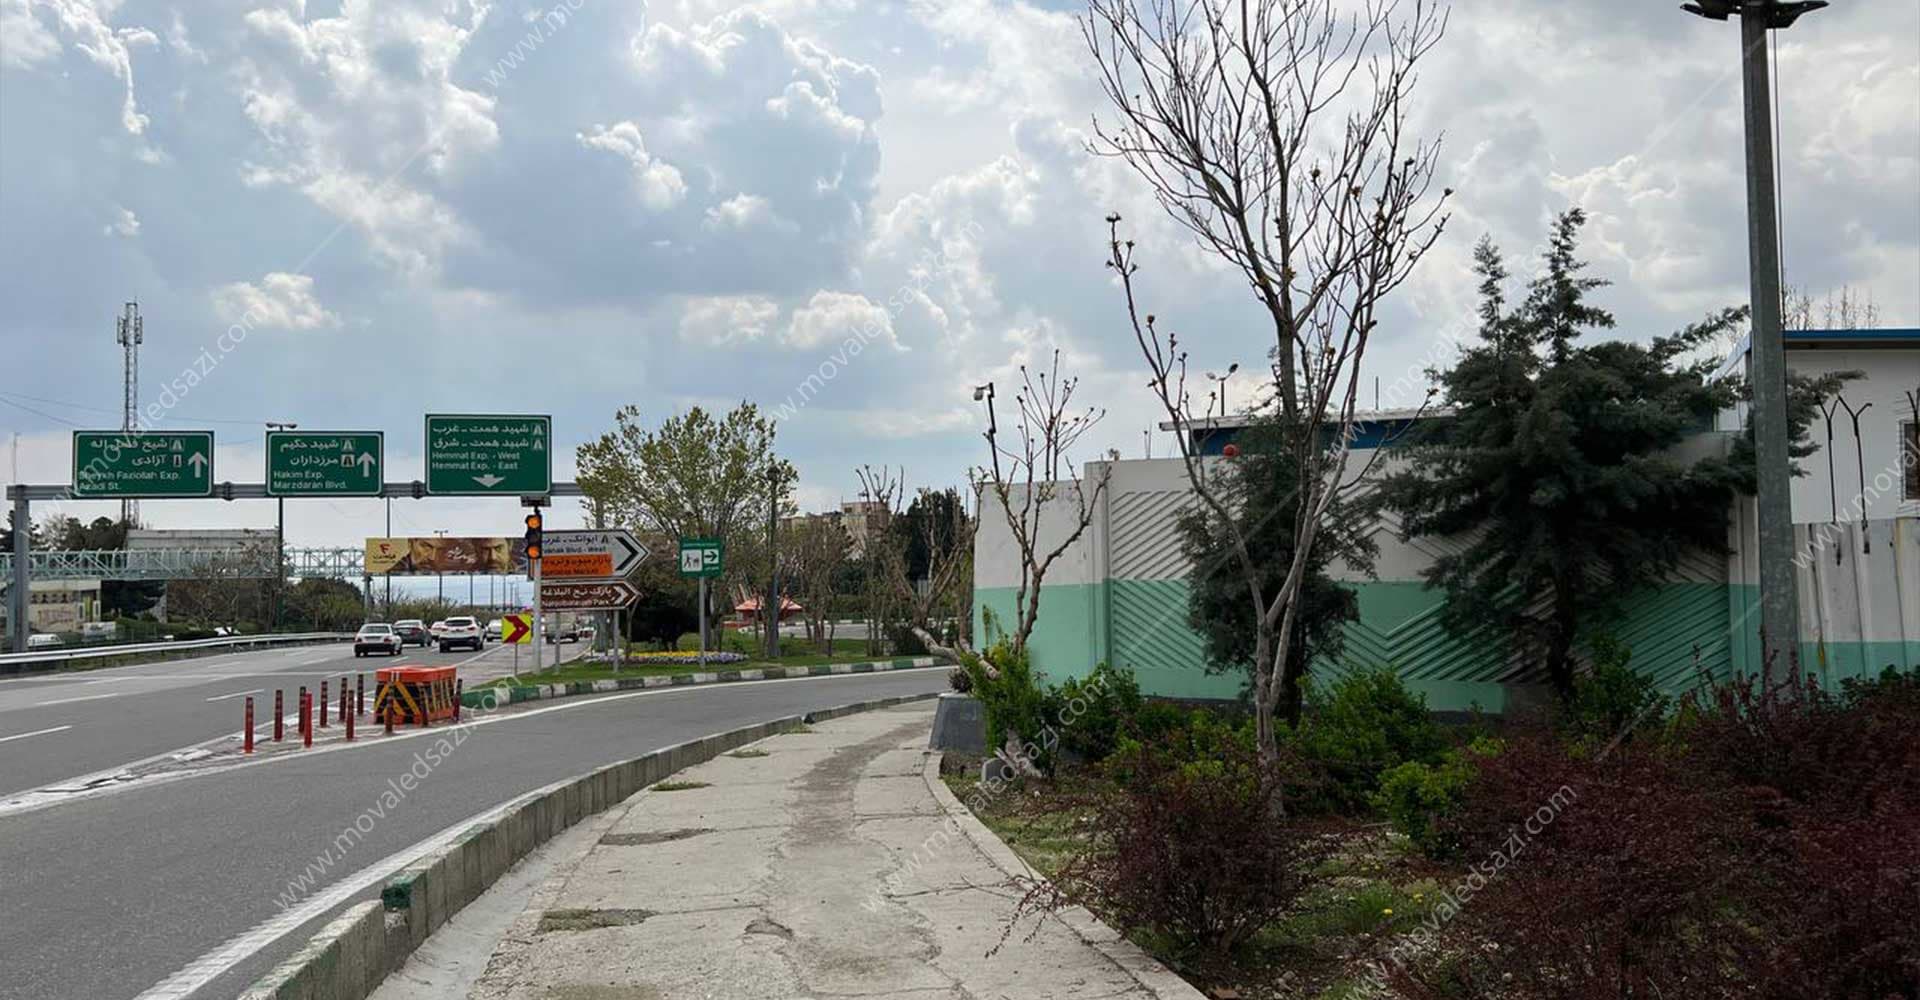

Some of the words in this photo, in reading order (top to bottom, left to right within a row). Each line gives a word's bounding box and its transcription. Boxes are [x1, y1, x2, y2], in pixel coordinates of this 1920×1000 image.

[433, 425, 460, 435] غرب
[470, 425, 499, 433] همت
[501, 424, 529, 434] شهید
[280, 440, 308, 453] حکیم
[310, 440, 339, 450] شهید
[433, 438, 460, 449] شرق
[470, 438, 499, 447] همت
[502, 438, 529, 447] شهید
[132, 454, 166, 466] آزادی
[290, 455, 339, 466] مرزداران
[274, 471, 303, 479] Hakim
[274, 481, 324, 489] Marzdaran
